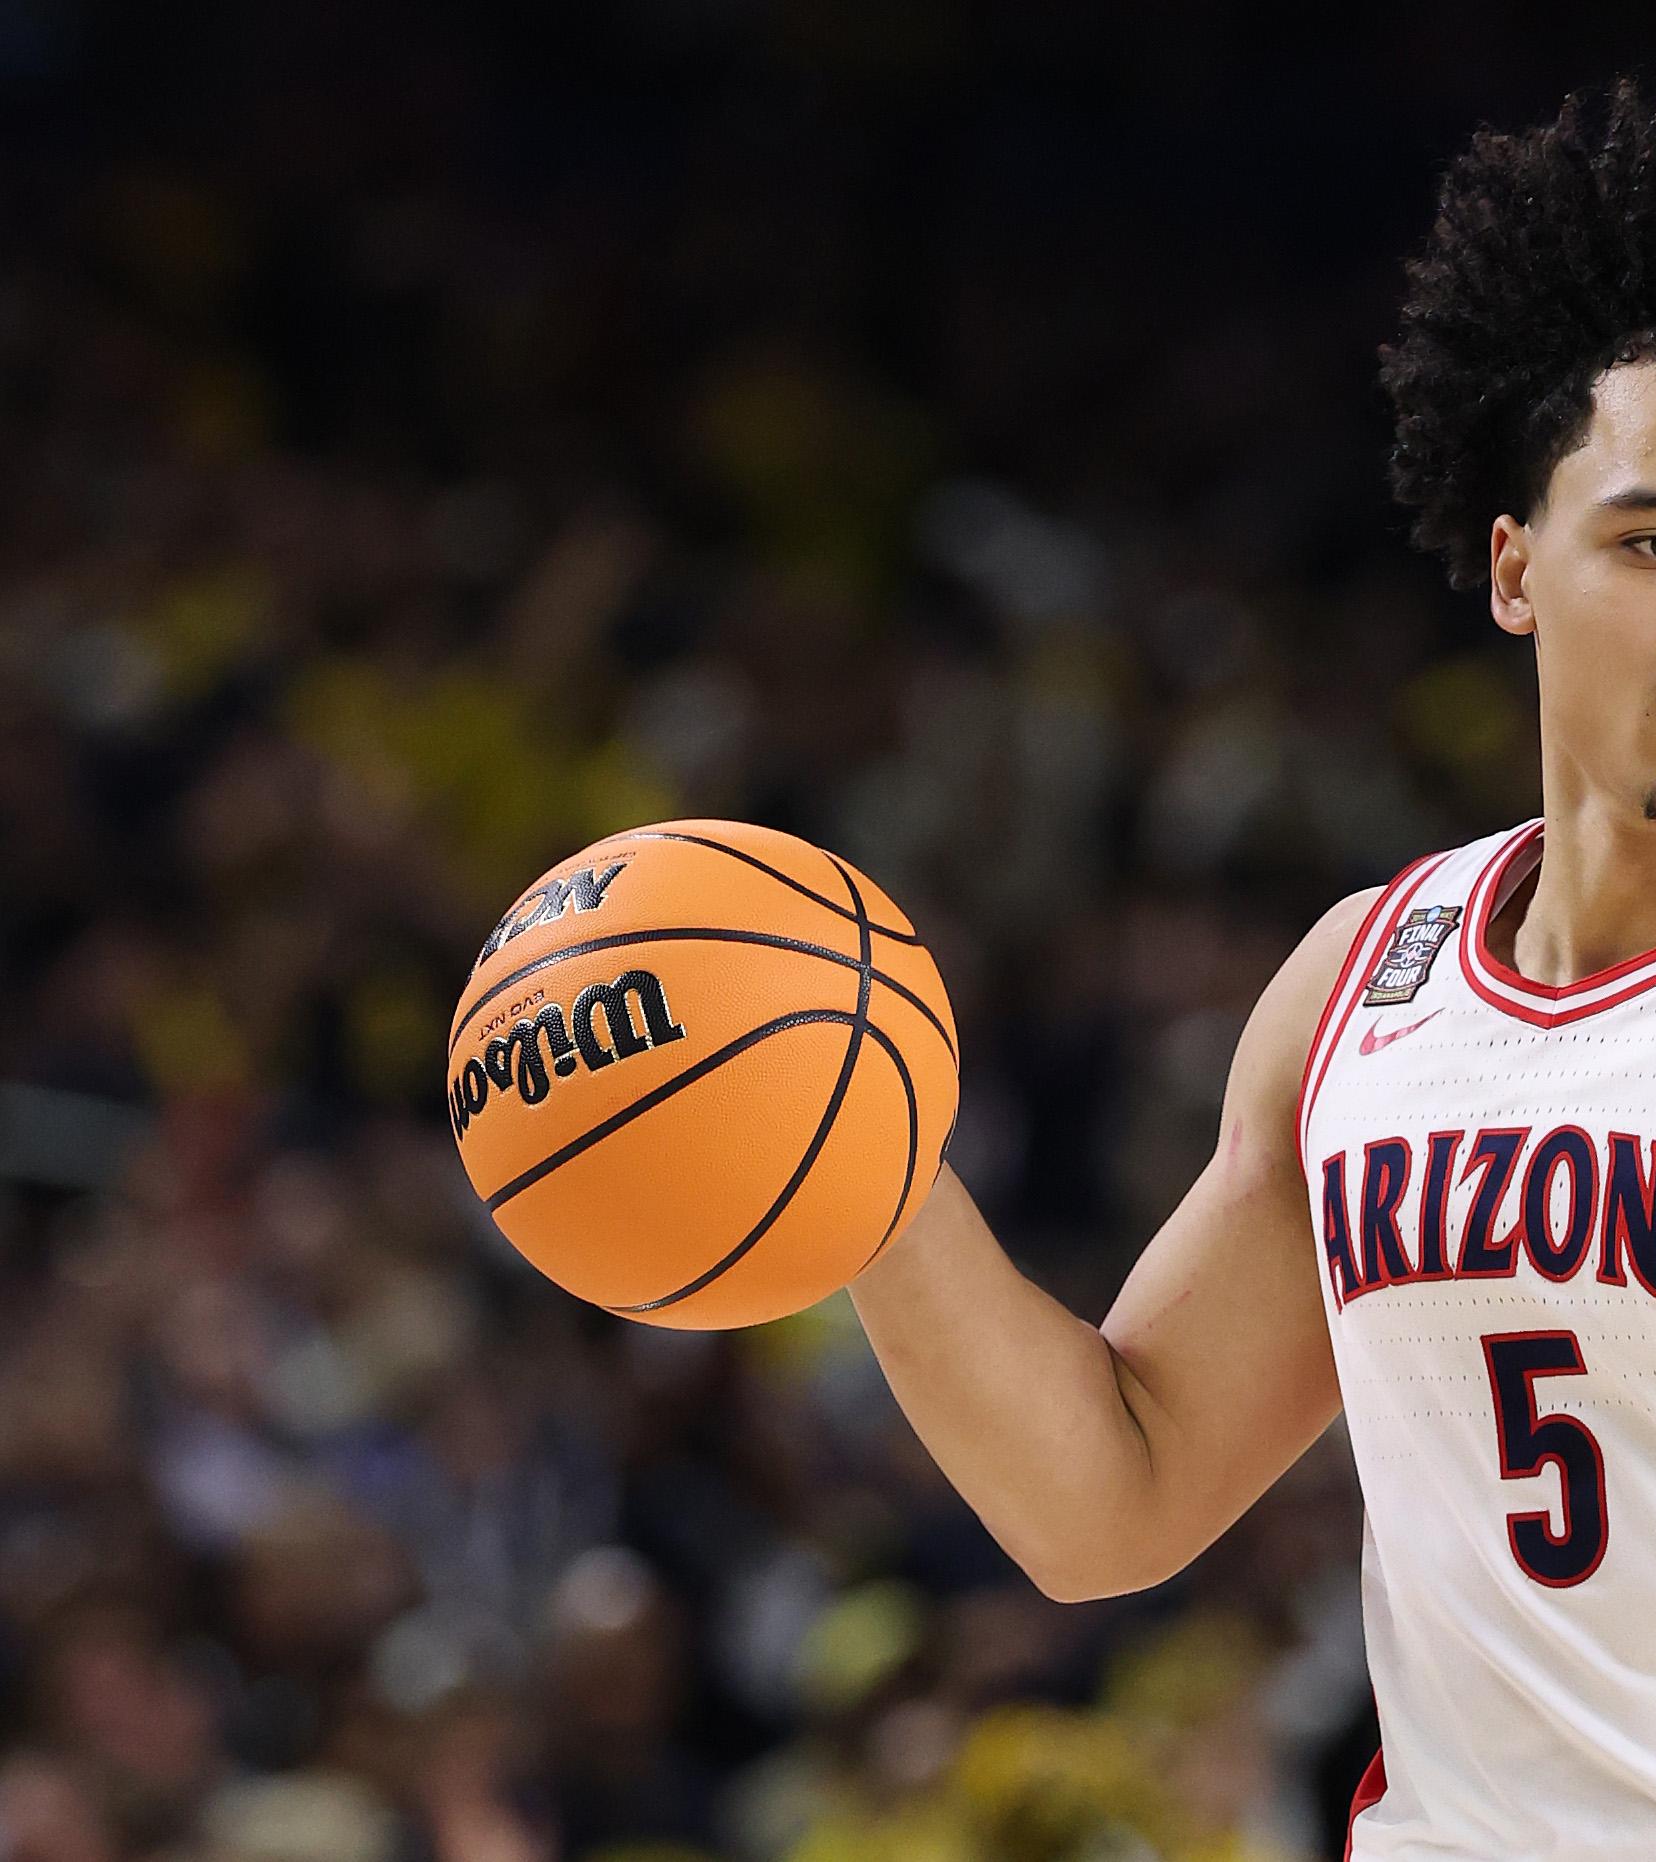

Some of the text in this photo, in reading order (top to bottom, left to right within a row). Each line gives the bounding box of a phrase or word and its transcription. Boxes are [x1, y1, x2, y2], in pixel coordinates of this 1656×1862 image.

[1400, 924, 1445, 945] FINAL
[1377, 966, 1422, 987] FOUR
[478, 989, 545, 1041] EVO NXT
[449, 969, 687, 1143] Wilson
[1480, 1329, 1609, 1588] 5
